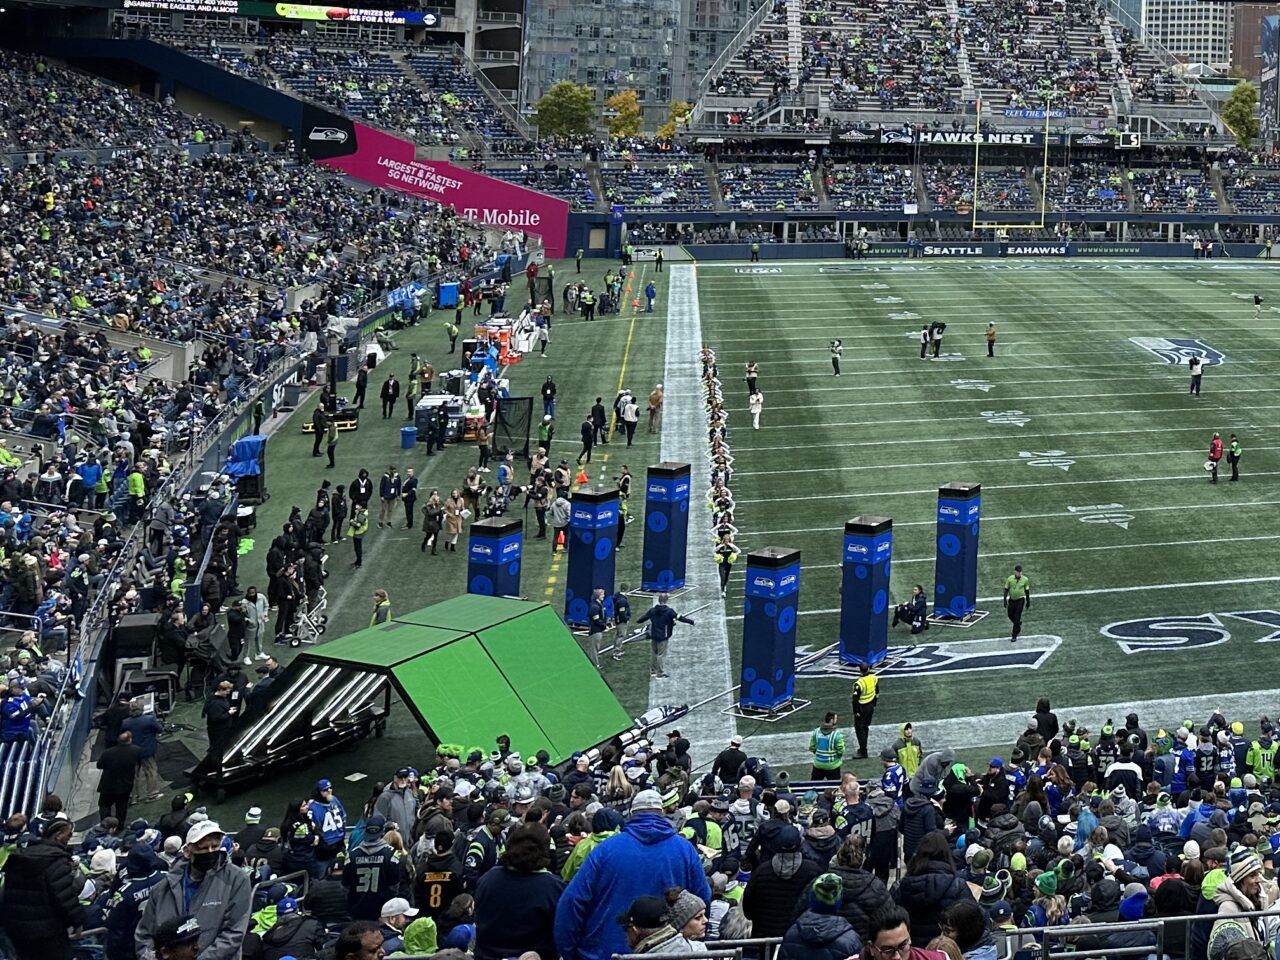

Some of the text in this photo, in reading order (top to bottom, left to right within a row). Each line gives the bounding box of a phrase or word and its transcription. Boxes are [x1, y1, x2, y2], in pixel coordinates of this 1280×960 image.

[170, 4, 196, 12] EAGLES,
[1005, 110, 1023, 118] FEEL
[1025, 110, 1040, 118] THE
[920, 132, 1034, 144] HAWKS NEST
[377, 156, 462, 190] LARGEST & FASTEST
[388, 170, 446, 194] 5G NETWORK
[924, 246, 983, 254] SEATTLE
[1201, 756, 1214, 771] 32
[1261, 752, 1273, 766] 14
[322, 810, 343, 833] 45
[723, 828, 740, 853] 16
[356, 867, 380, 893] 31
[430, 884, 442, 908] 8
